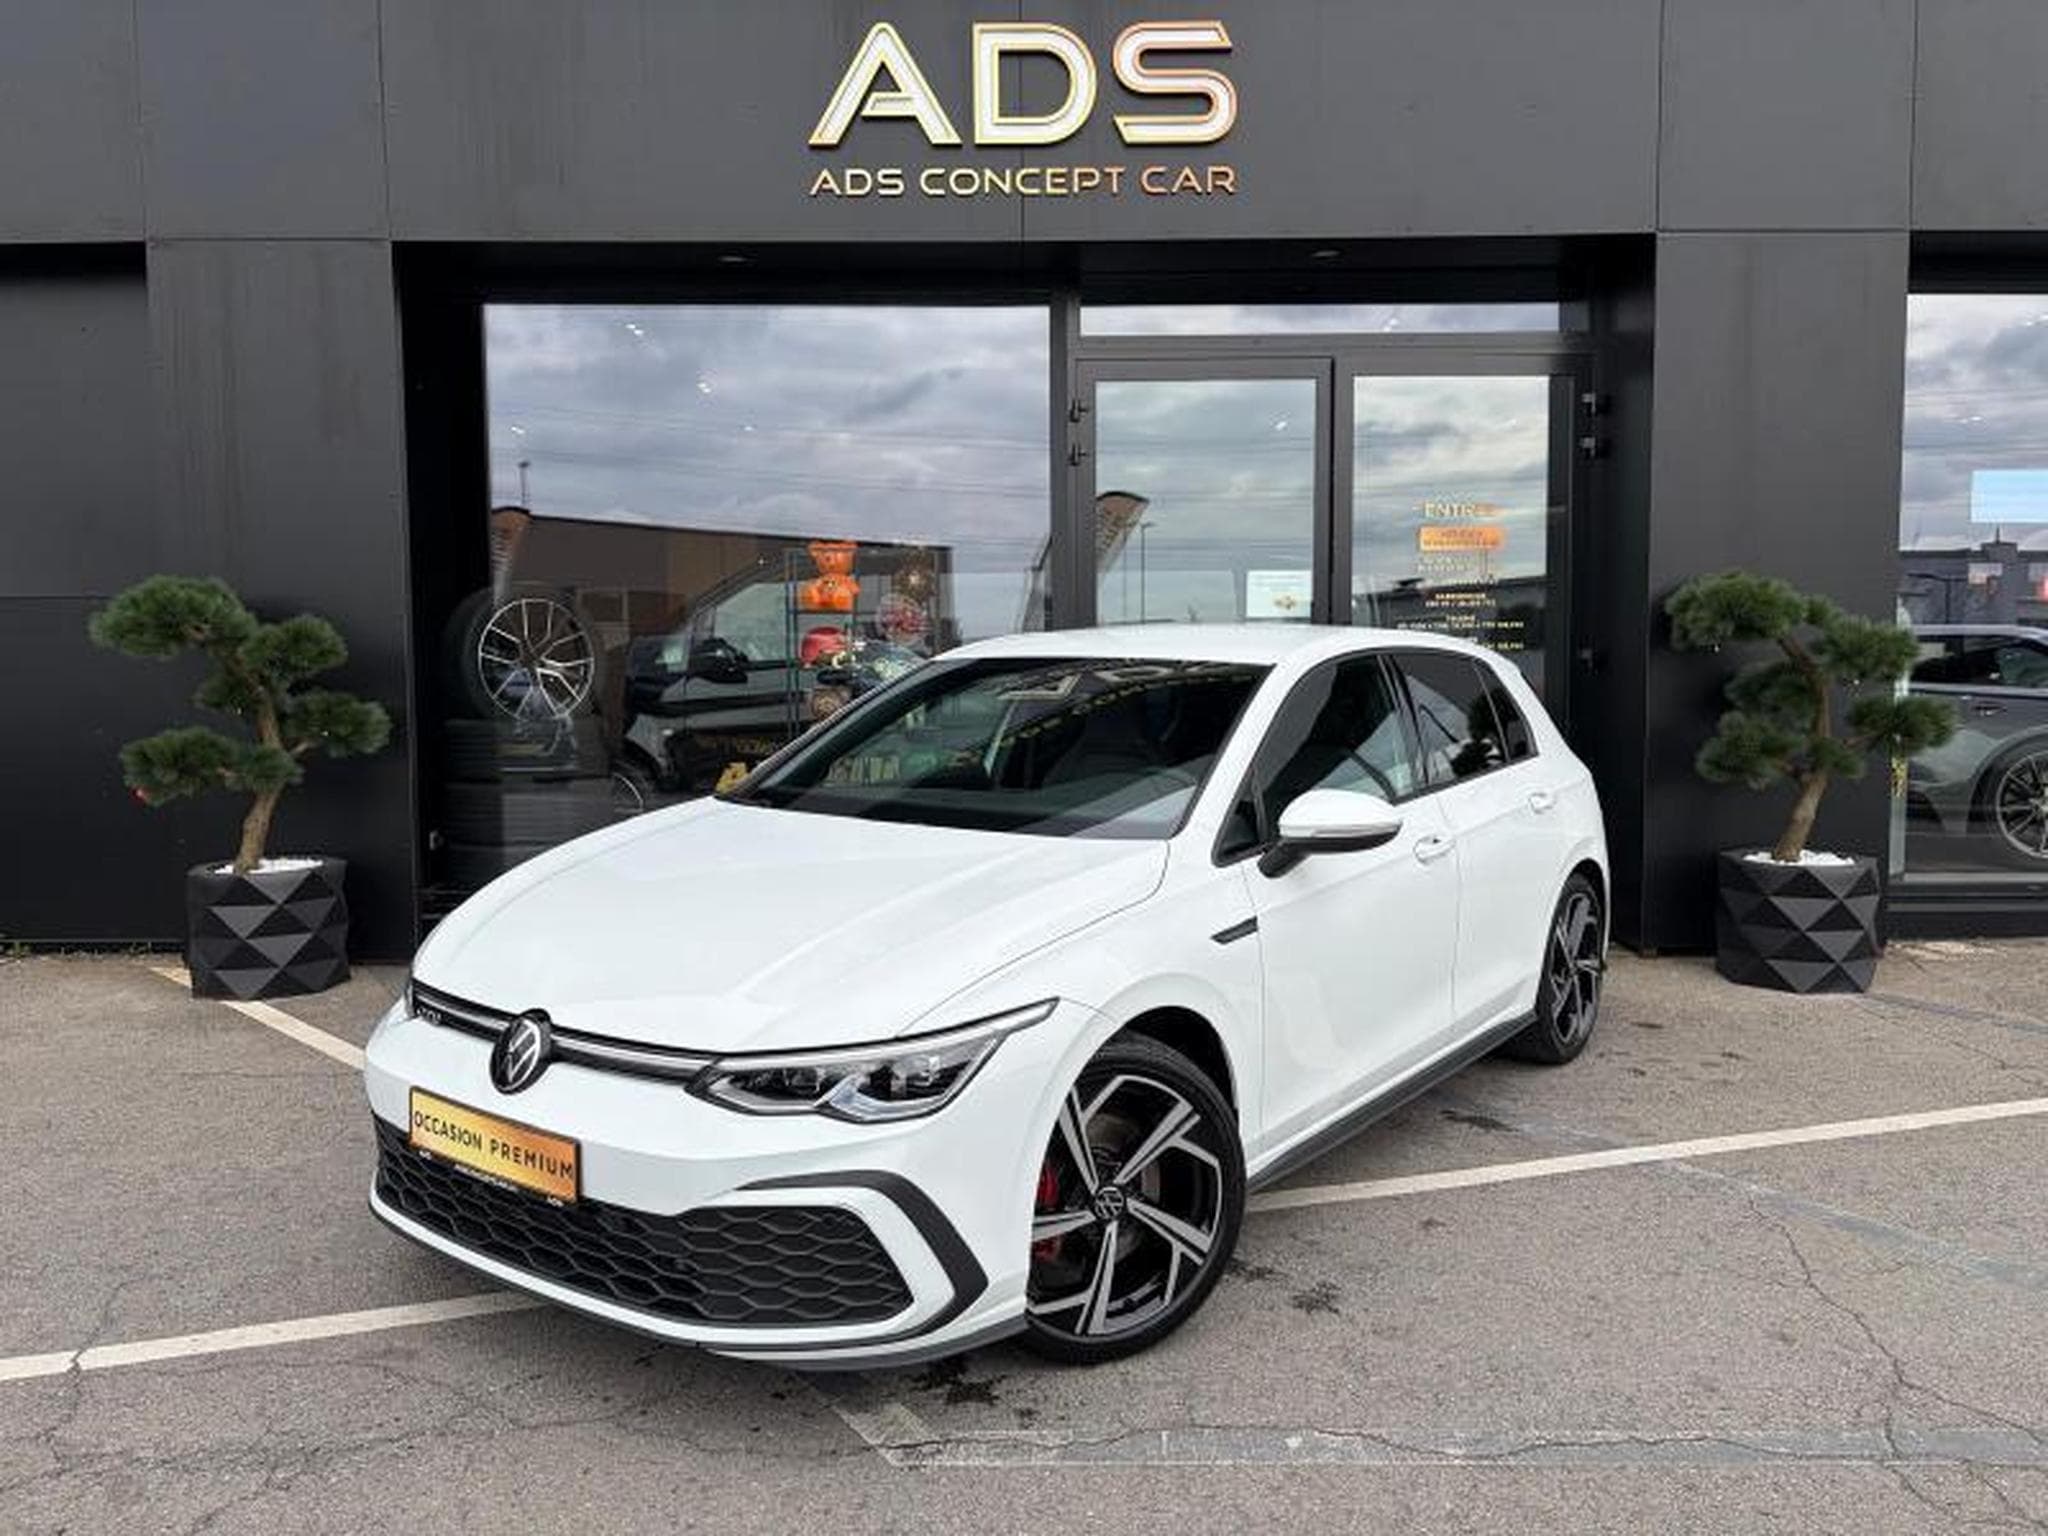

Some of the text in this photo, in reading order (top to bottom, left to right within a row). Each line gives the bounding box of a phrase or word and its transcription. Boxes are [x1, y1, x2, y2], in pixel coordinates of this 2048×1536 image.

[808, 21, 1238, 145] ADS
[809, 165, 1237, 196] ADS CONCEPT CAR
[413, 1109, 483, 1152] OCCASION
[489, 1139, 574, 1179] PREMIUM
